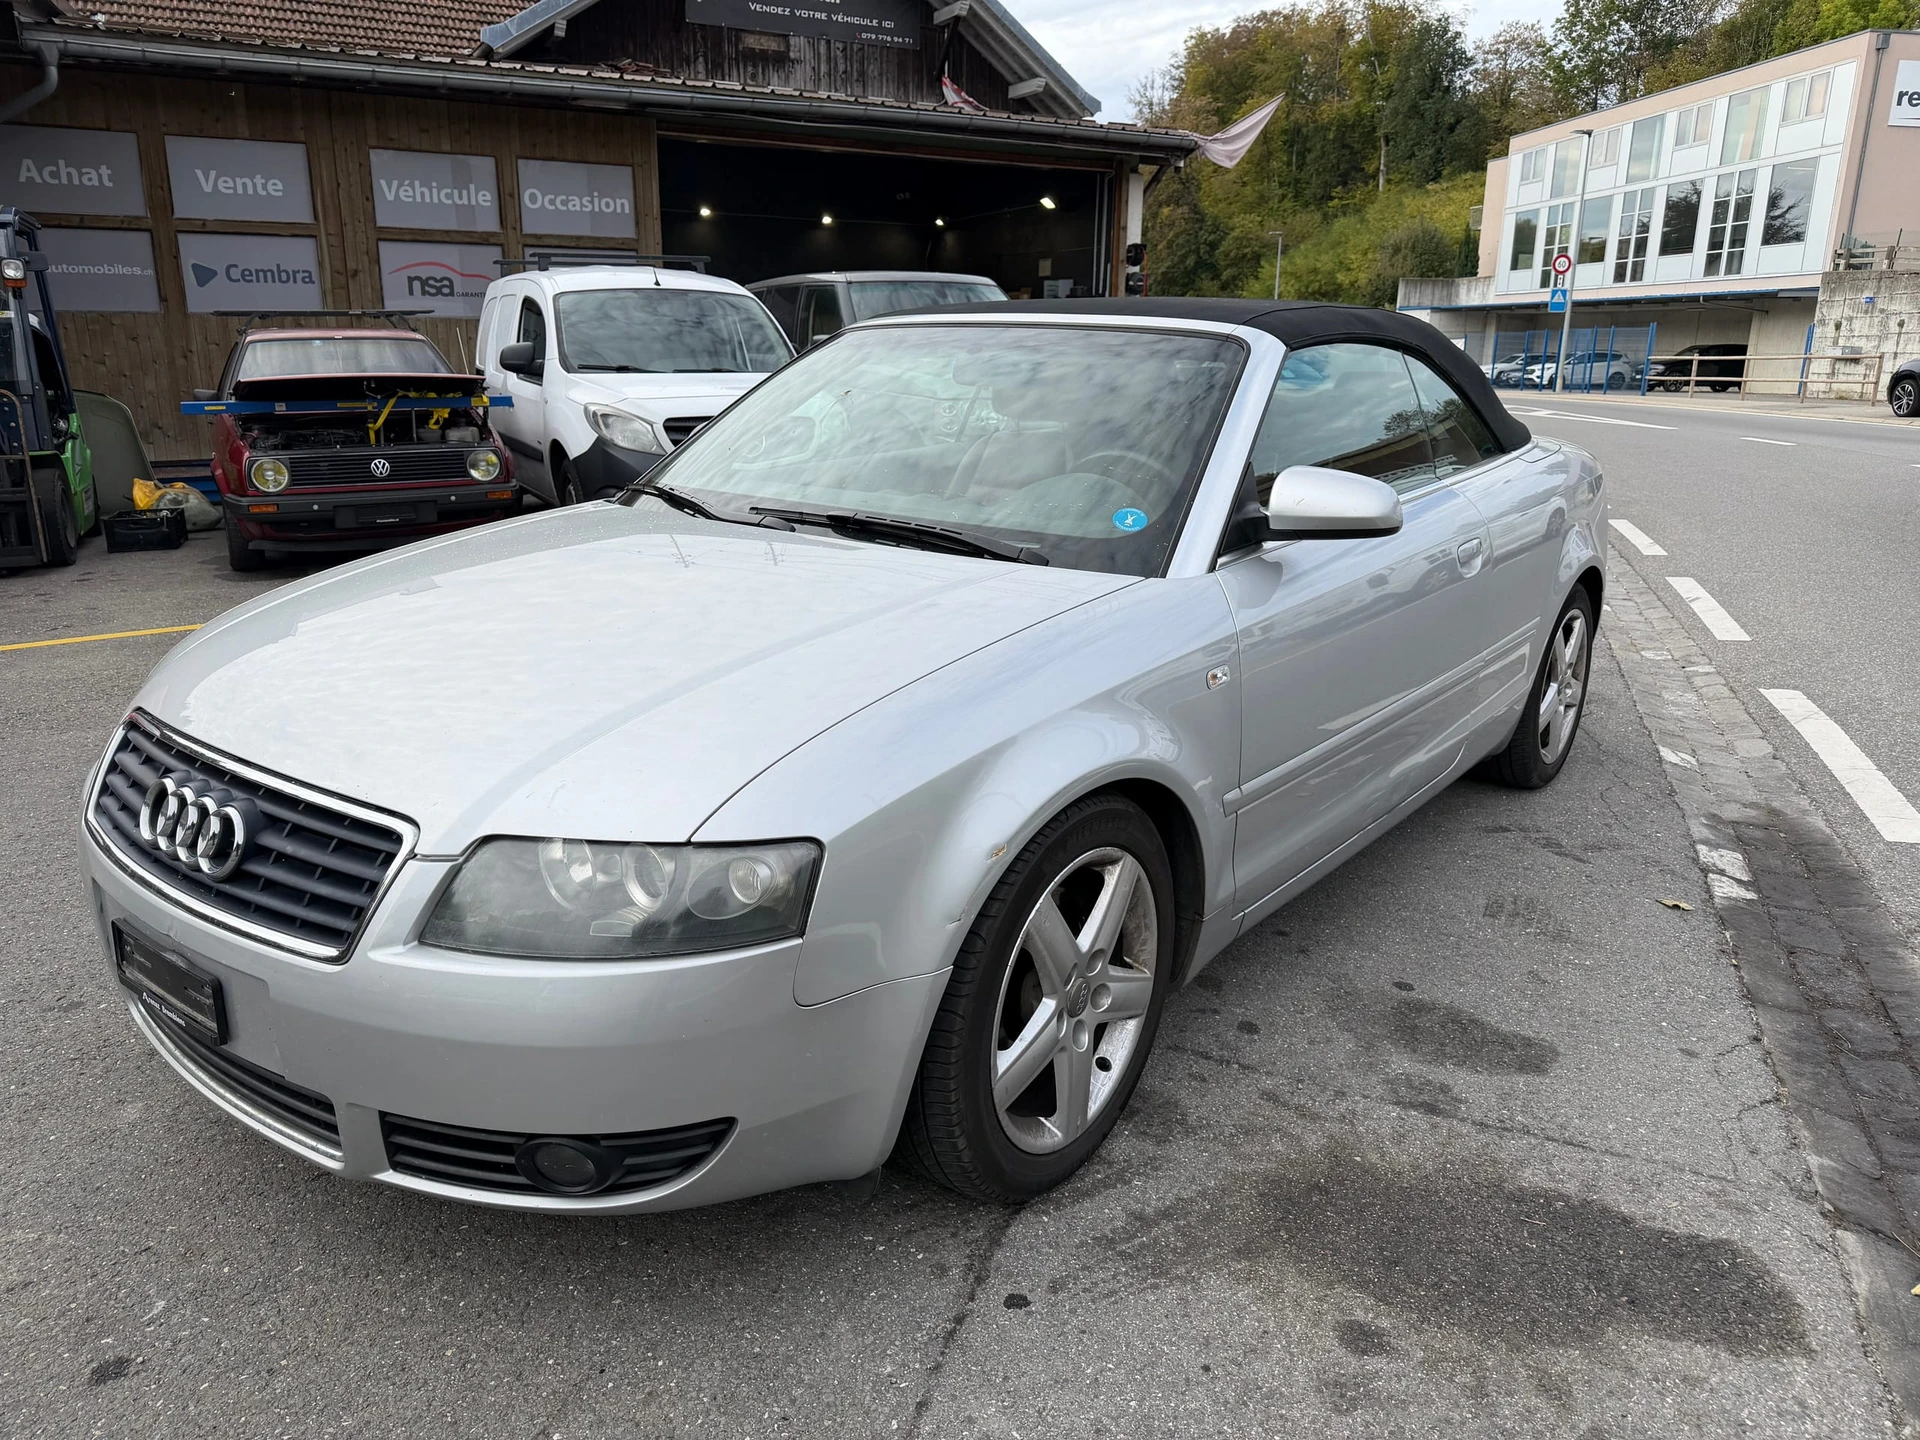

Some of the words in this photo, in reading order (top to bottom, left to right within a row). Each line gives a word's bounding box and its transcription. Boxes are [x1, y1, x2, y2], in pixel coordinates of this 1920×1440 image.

[861, 32, 876, 40] 079
[18, 158, 113, 187] Achat
[194, 169, 284, 196] Vente
[379, 179, 492, 206] Véhicule
[523, 188, 630, 214] Occasion
[224, 263, 316, 285] Cembra
[1557, 260, 1567, 268] 60
[407, 275, 455, 297] nsa
